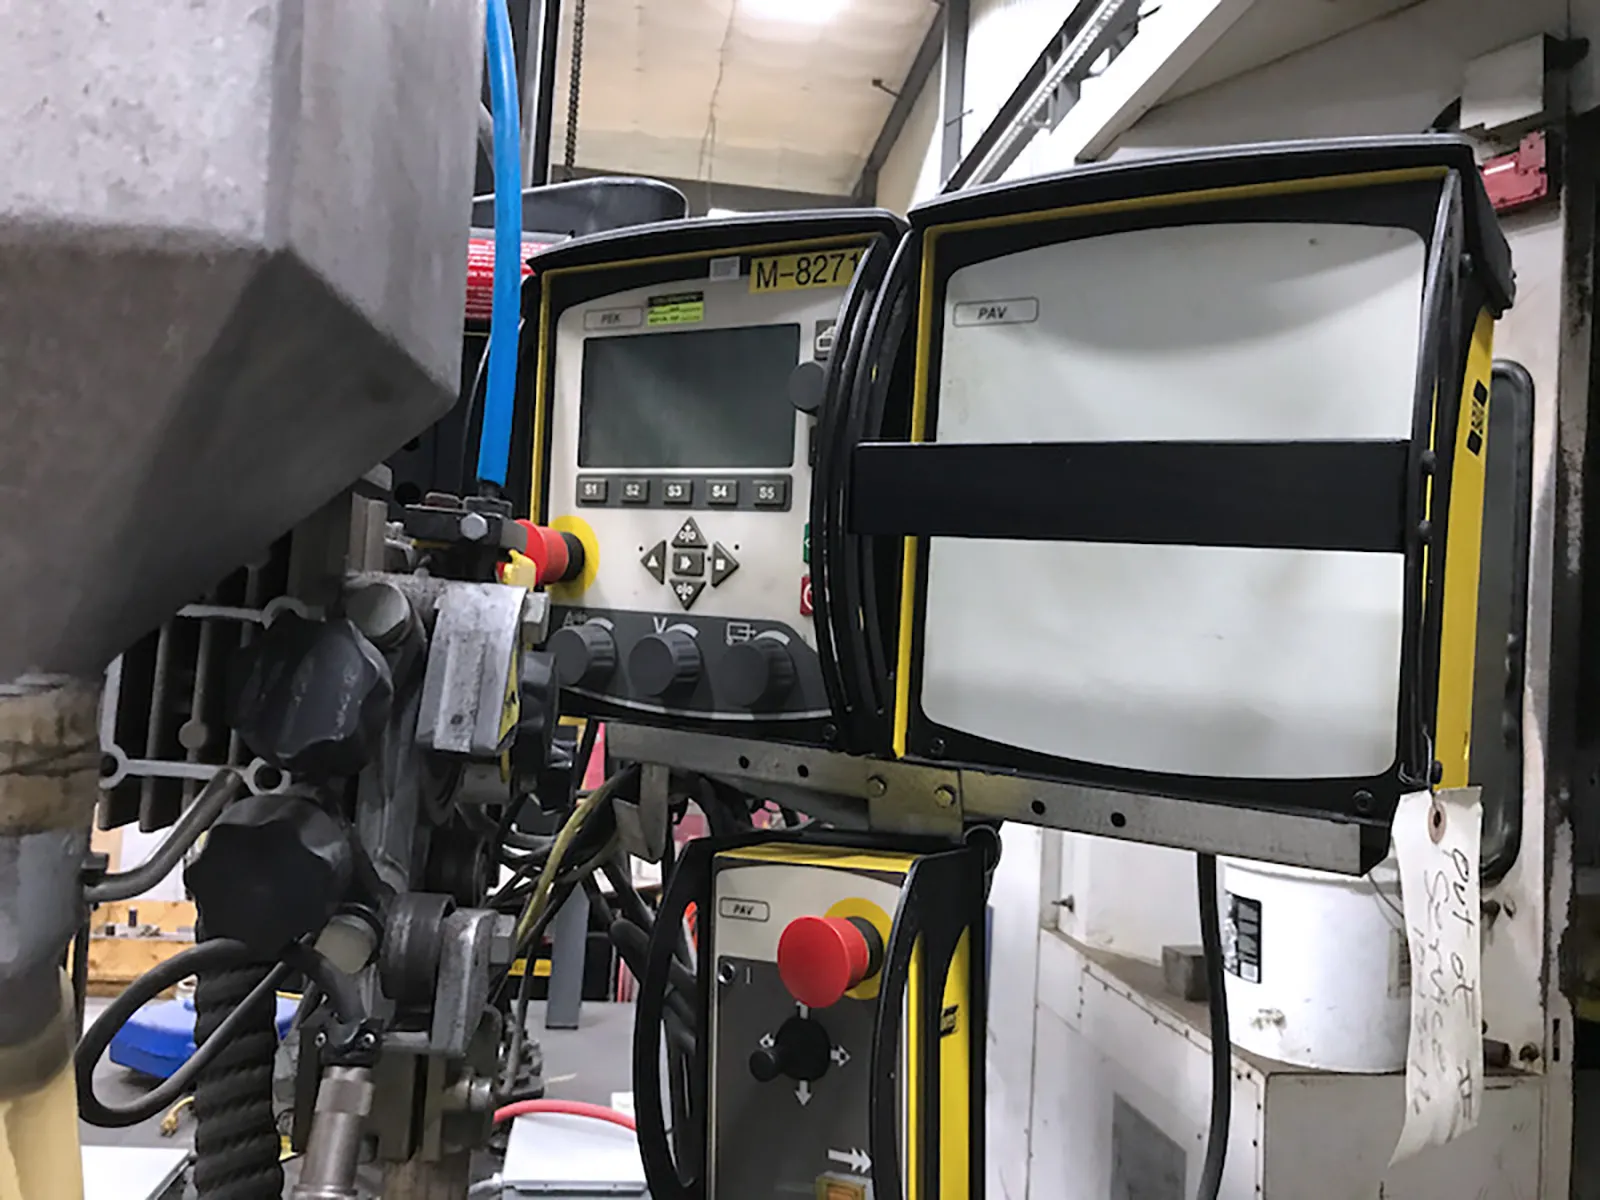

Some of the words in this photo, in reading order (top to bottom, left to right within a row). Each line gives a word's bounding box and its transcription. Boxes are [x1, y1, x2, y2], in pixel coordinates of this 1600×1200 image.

[756, 252, 860, 289] M-8271
[977, 305, 1008, 320] PAV
[584, 484, 598, 496] S1
[625, 484, 641, 496] S2
[667, 485, 682, 498] S3
[711, 485, 728, 498] S4
[759, 487, 775, 500] S5
[653, 616, 668, 634] V
[733, 903, 754, 916] PAV
